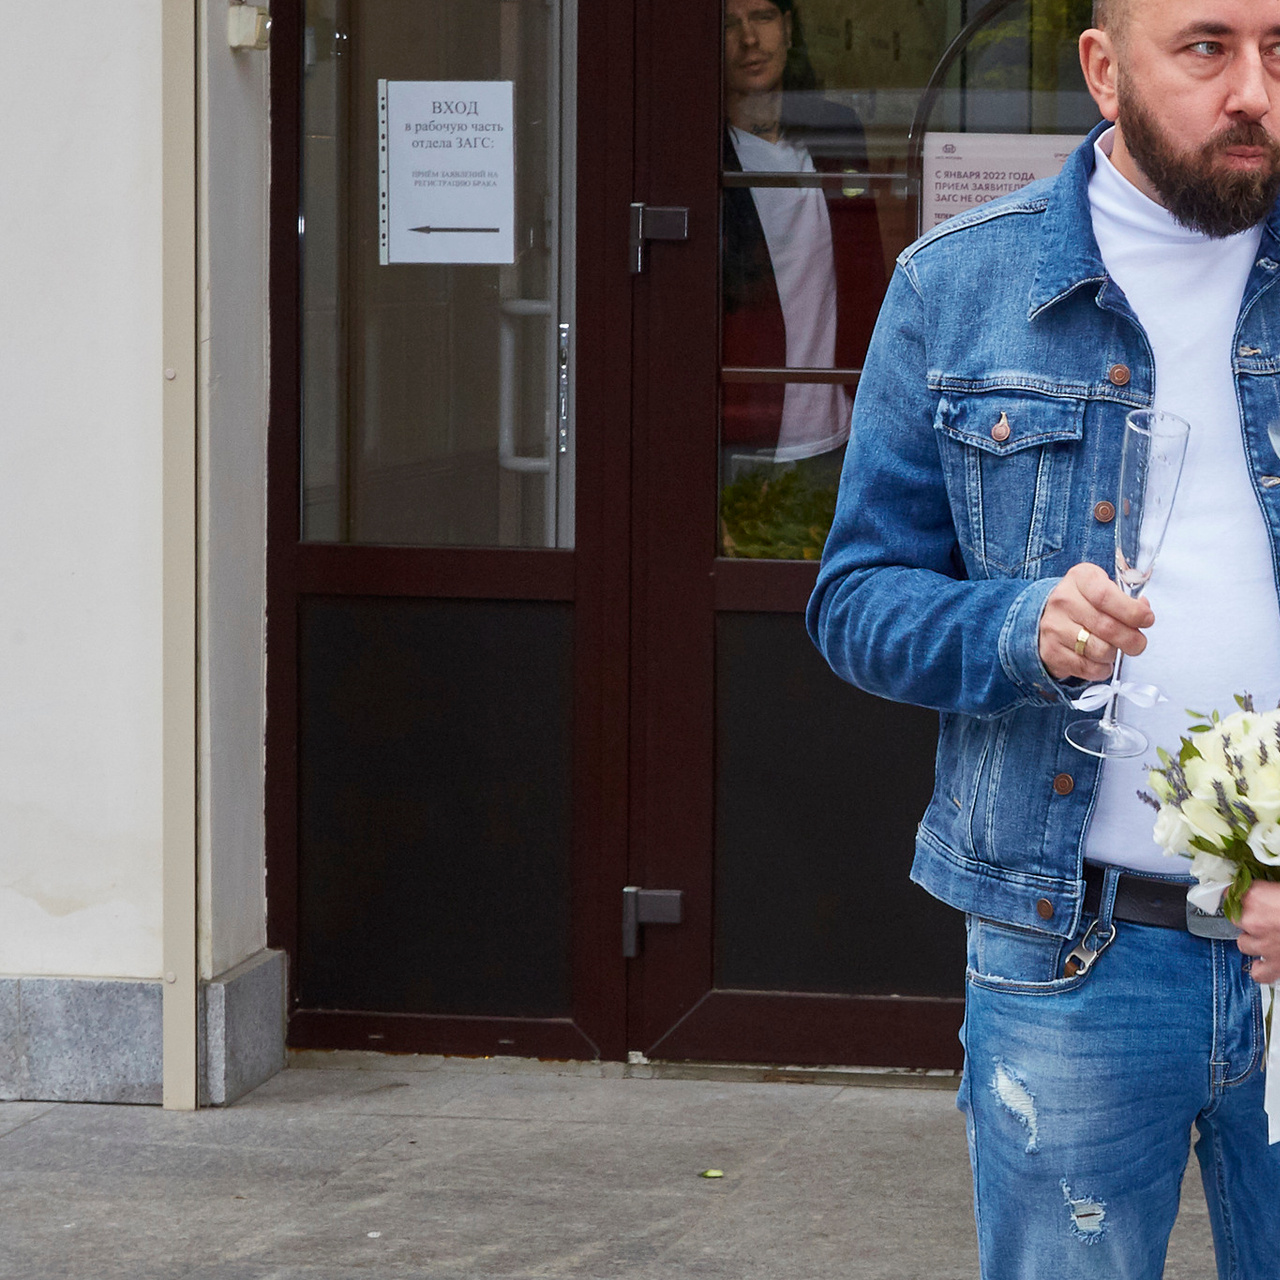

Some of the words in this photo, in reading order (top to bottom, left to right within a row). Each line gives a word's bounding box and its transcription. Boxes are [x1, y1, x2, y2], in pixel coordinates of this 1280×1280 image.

[432, 101, 479, 116] ВХОД
[404, 123, 412, 132] в
[415, 120, 468, 134] рабочую
[471, 123, 504, 132] часть
[411, 140, 452, 149] отдела
[456, 137, 495, 149] ЗАГС:
[935, 170, 942, 179] С
[943, 170, 981, 179] ЯНВАРЯ
[983, 171, 1006, 180] 2022
[1008, 172, 1036, 182] ГОДА
[934, 182, 970, 191] ПРИЕМ
[935, 193, 959, 202] ЗАГС
[960, 194, 972, 203] НЕ
